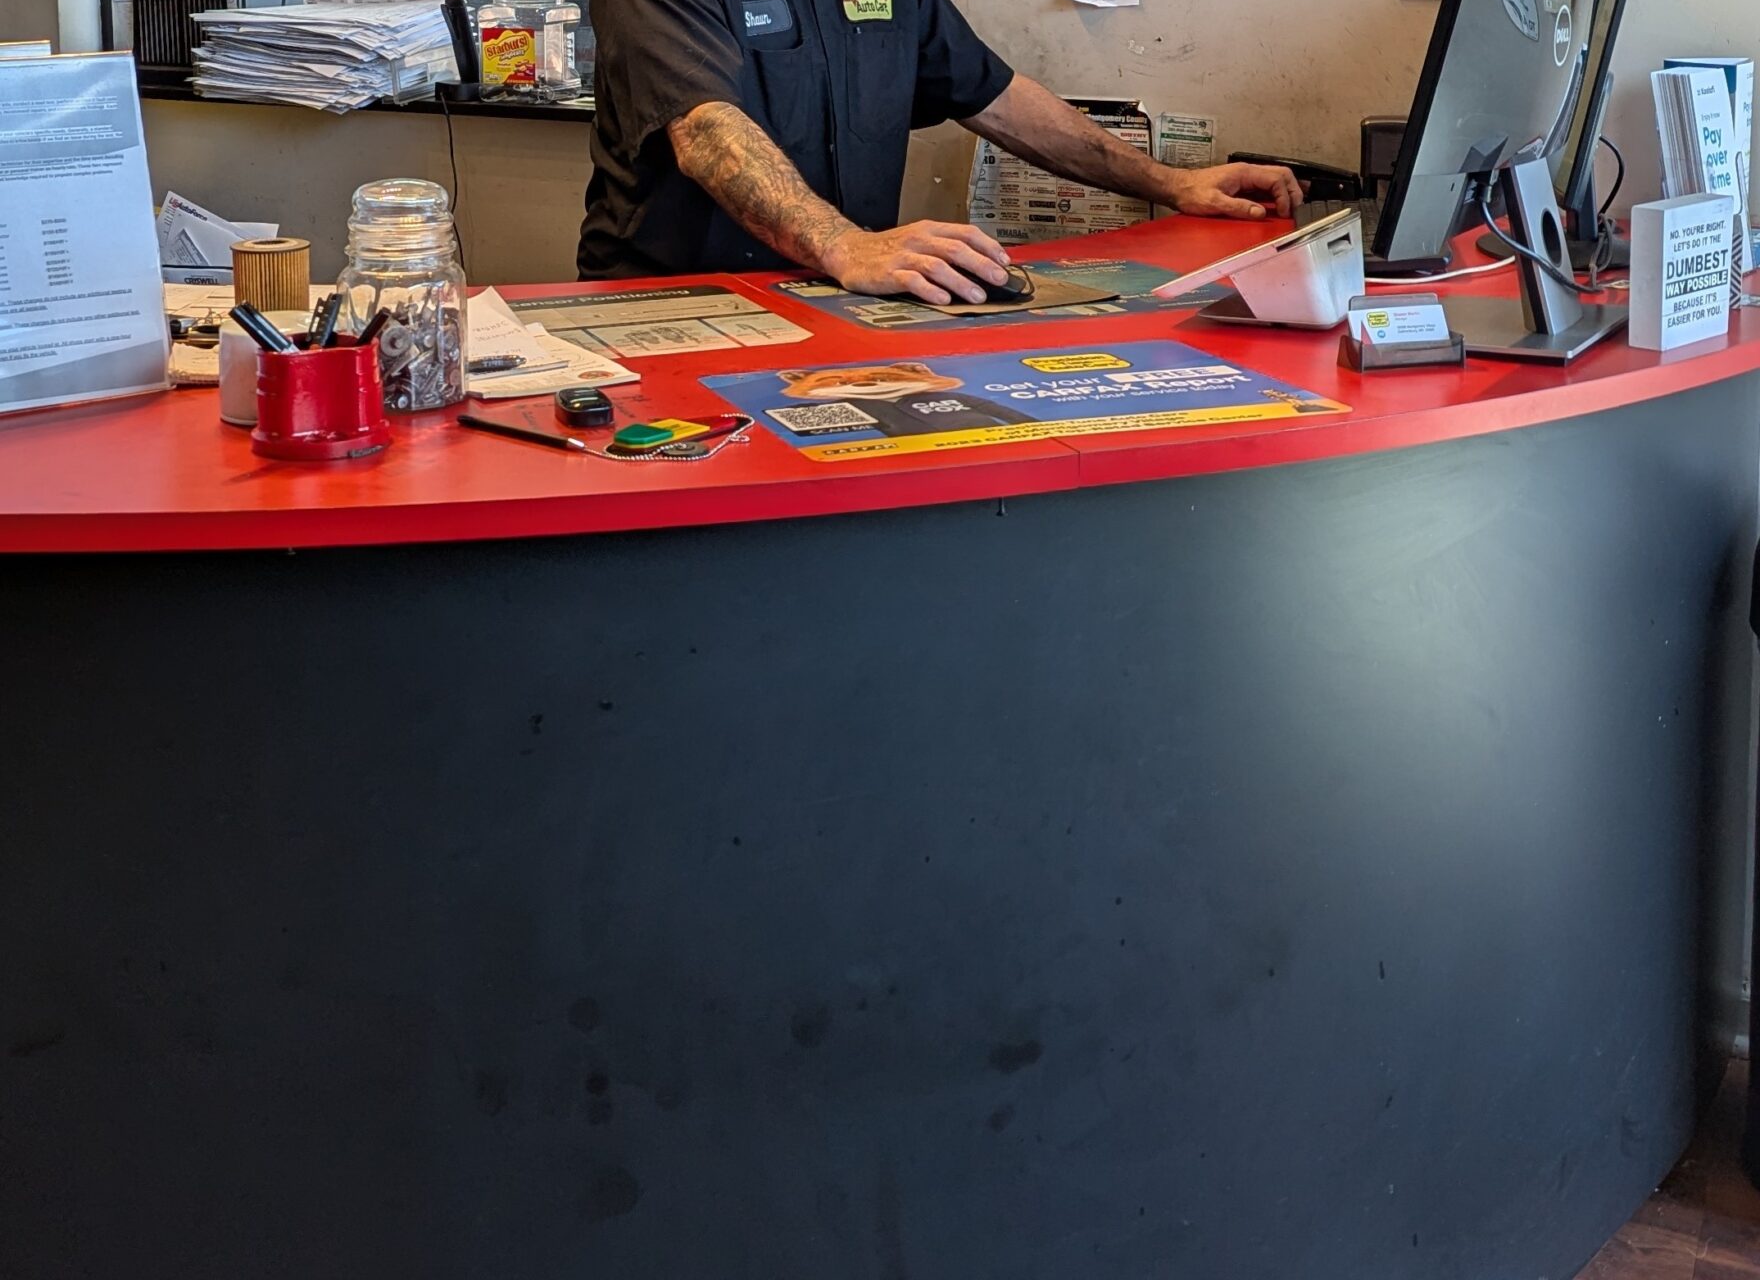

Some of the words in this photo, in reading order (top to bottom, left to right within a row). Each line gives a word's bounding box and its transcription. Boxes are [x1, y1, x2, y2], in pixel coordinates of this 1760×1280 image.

[486, 36, 528, 57] Starburst
[1703, 126, 1722, 148] Pay
[1706, 150, 1728, 168] over
[1670, 231, 1680, 240] NO.
[1682, 224, 1705, 236] YOU'RE
[1706, 220, 1726, 232] RIGHT.
[1674, 240, 1691, 252] LET'S
[1692, 238, 1701, 249] DO
[1702, 236, 1709, 246] IT
[1710, 234, 1722, 245] THE
[1666, 249, 1728, 280] DUMBEST
[778, 281, 809, 289] Air
[1666, 281, 1685, 296] WAY
[1688, 271, 1728, 292] POSSIBLE
[578, 290, 690, 302] Positioning
[1674, 296, 1704, 312] BECAUSE
[1705, 292, 1717, 303] IT'S
[1667, 314, 1691, 328] EASIER
[1692, 310, 1705, 321] FOR
[1706, 305, 1722, 318] YOU.
[1032, 356, 1106, 364] Precision
[984, 382, 1038, 392] Get
[1042, 377, 1102, 388] your
[1132, 368, 1216, 380] FREE
[1010, 384, 1140, 400] CARFAX
[1144, 375, 1252, 389] Report
[1052, 394, 1088, 402] with
[1091, 392, 1126, 400] your
[1130, 388, 1188, 396] service
[911, 400, 959, 410] CAR
[918, 406, 971, 414] FOX
[984, 422, 1066, 432] Precision
[985, 434, 1050, 444] CARFAX
[1056, 424, 1141, 435] Top-Rated
[1143, 418, 1206, 427] Service
[1022, 422, 1129, 434] Montgomery
